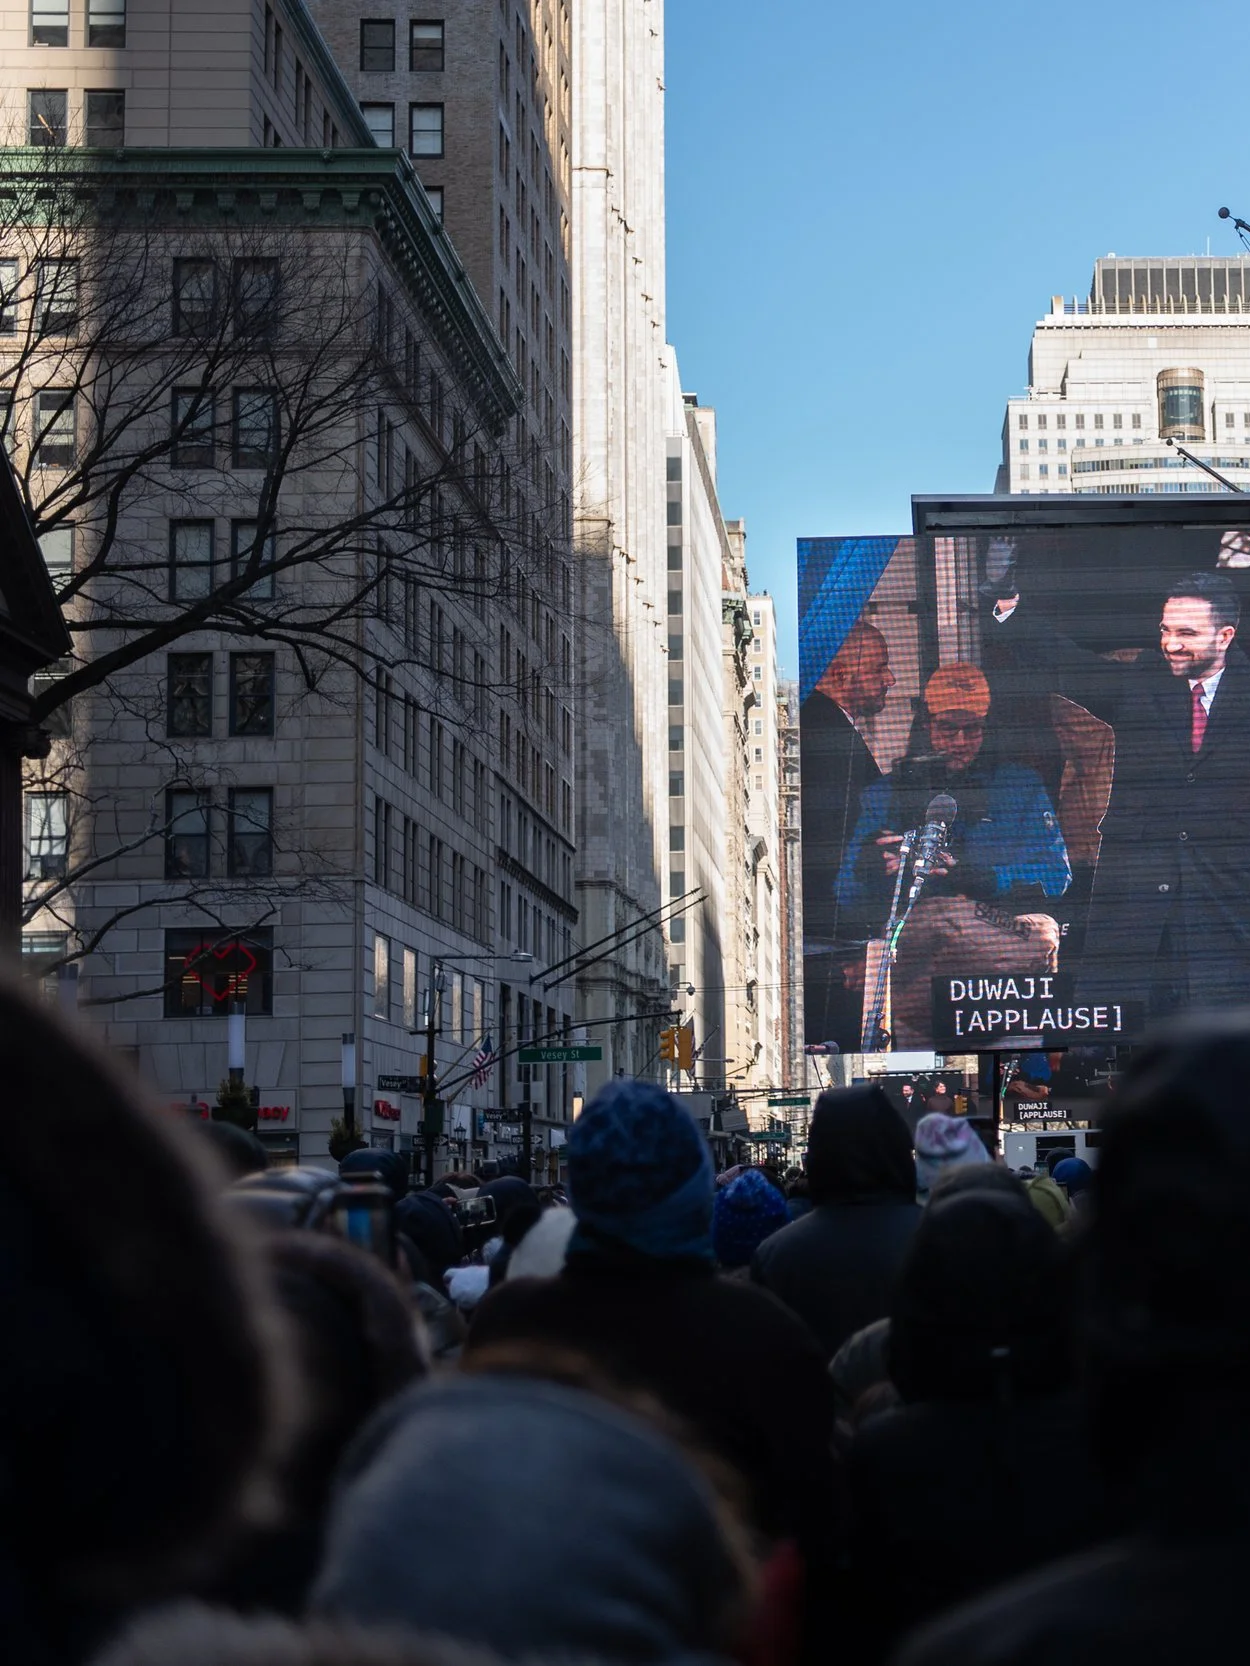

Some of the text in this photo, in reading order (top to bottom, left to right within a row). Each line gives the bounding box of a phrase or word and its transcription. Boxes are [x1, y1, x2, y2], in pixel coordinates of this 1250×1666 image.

[950, 977, 1054, 1001] DUWAJI
[955, 1005, 1123, 1036] [APPLAUSE]
[541, 1050, 579, 1060] Vesey St
[381, 1079, 401, 1089] Vesey
[485, 1111, 503, 1119] Vesey
[1019, 1110, 1067, 1119] [APPLAUSE]
